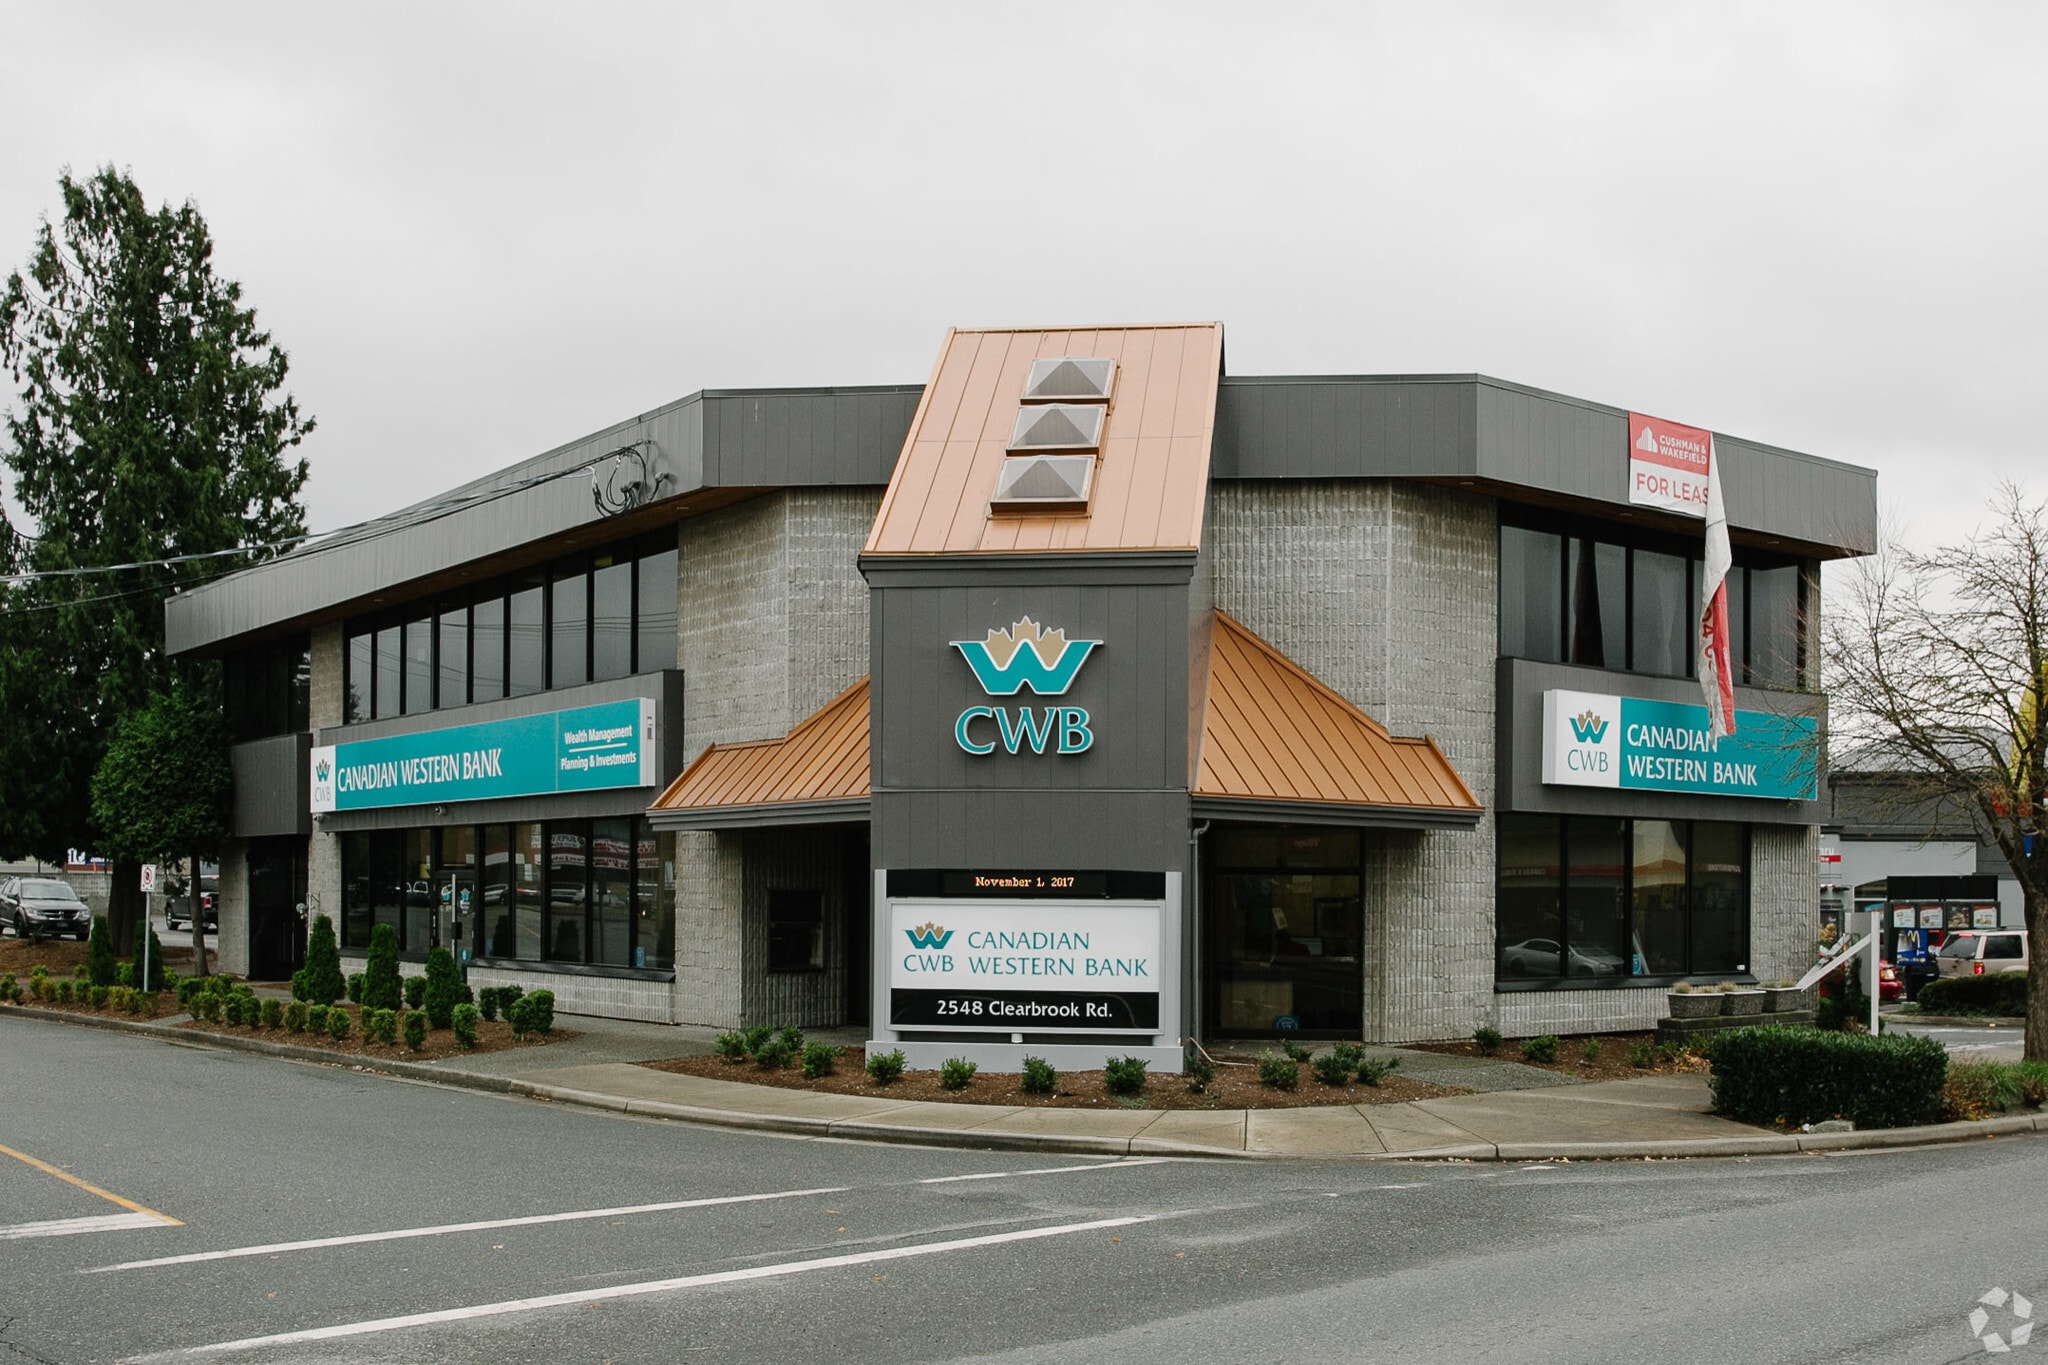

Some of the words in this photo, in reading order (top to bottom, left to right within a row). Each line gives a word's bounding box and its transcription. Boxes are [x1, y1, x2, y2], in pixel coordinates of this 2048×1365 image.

[1660, 434, 1700, 453] CUSHMAN
[1700, 444, 1707, 455] &
[1660, 444, 1708, 466] WAKEFIELD
[1636, 472, 1669, 497] FOR
[1672, 480, 1709, 506] LEAS
[564, 729, 588, 745] Wealth
[588, 724, 633, 743] Management
[954, 705, 1095, 755] CWB
[1626, 723, 1718, 754] CANADIAN
[337, 760, 398, 793] CANADIAN
[400, 752, 460, 786] WESTERN
[462, 747, 503, 780] BANK
[560, 755, 589, 772] Planning
[589, 754, 595, 768] &
[595, 751, 637, 767] Investments
[1567, 748, 1609, 773] CWB
[1626, 754, 1708, 783] WESTERN
[1713, 761, 1758, 787] BANK
[314, 786, 332, 803] CWB
[975, 876, 1032, 887] November
[1036, 877, 1045, 888] 1,
[1051, 877, 1075, 888] 2017
[968, 931, 1090, 951] CANADIAN
[903, 954, 954, 973] CWB
[968, 956, 1075, 976] WESTERN
[1085, 957, 1149, 977] BANK
[936, 999, 983, 1016] 2548
[988, 1000, 1080, 1017] Clearbrook
[1085, 1002, 1113, 1018] Rd.
